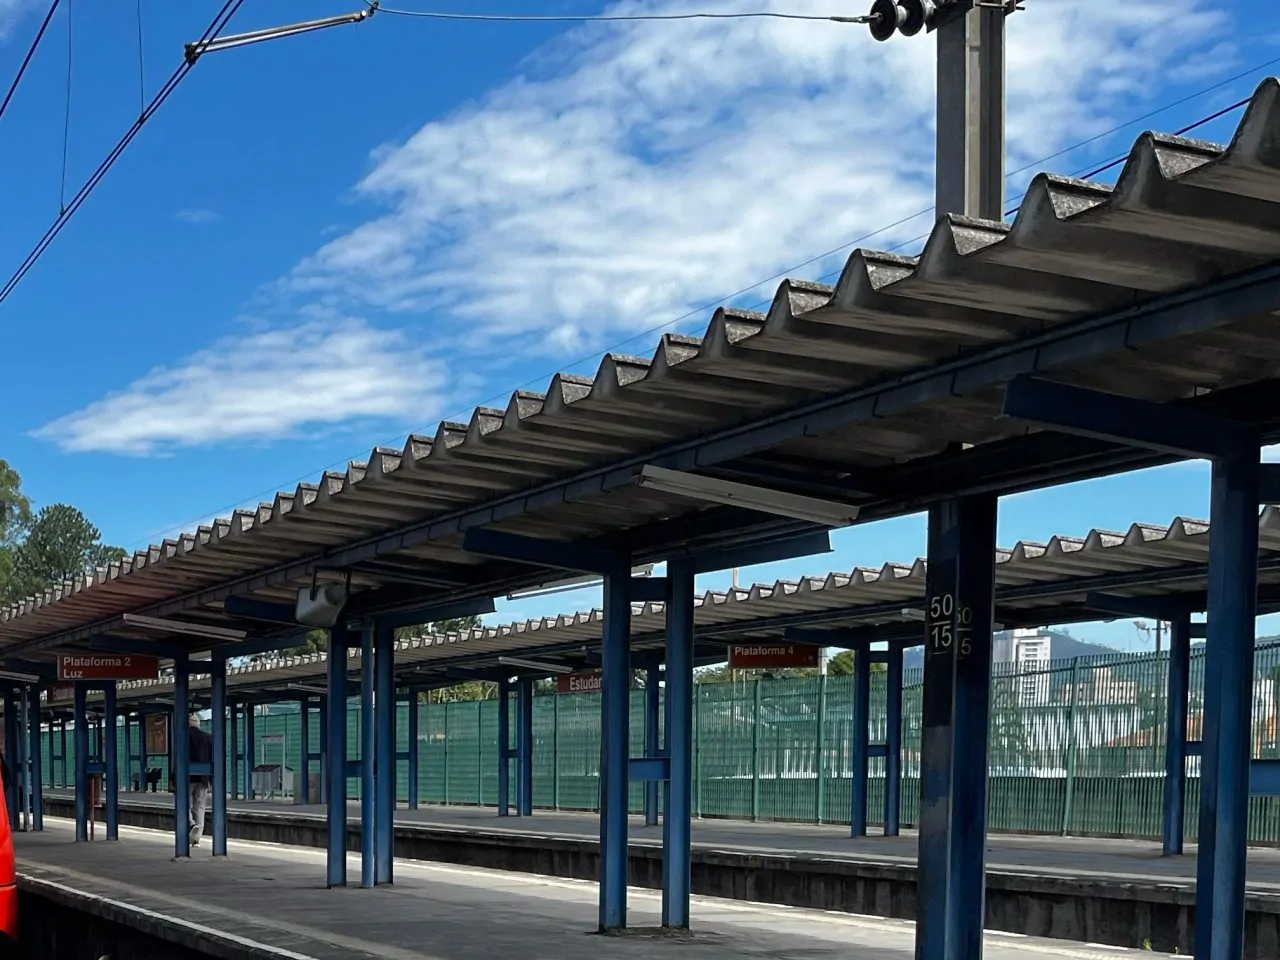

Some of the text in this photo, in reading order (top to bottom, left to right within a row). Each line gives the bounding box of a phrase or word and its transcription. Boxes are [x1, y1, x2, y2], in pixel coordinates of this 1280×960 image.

[930, 593, 953, 618] 50
[931, 625, 952, 648] 15
[734, 645, 794, 657] Plataforma 4
[63, 656, 132, 667] Plataforma 2
[63, 668, 84, 679] Luz
